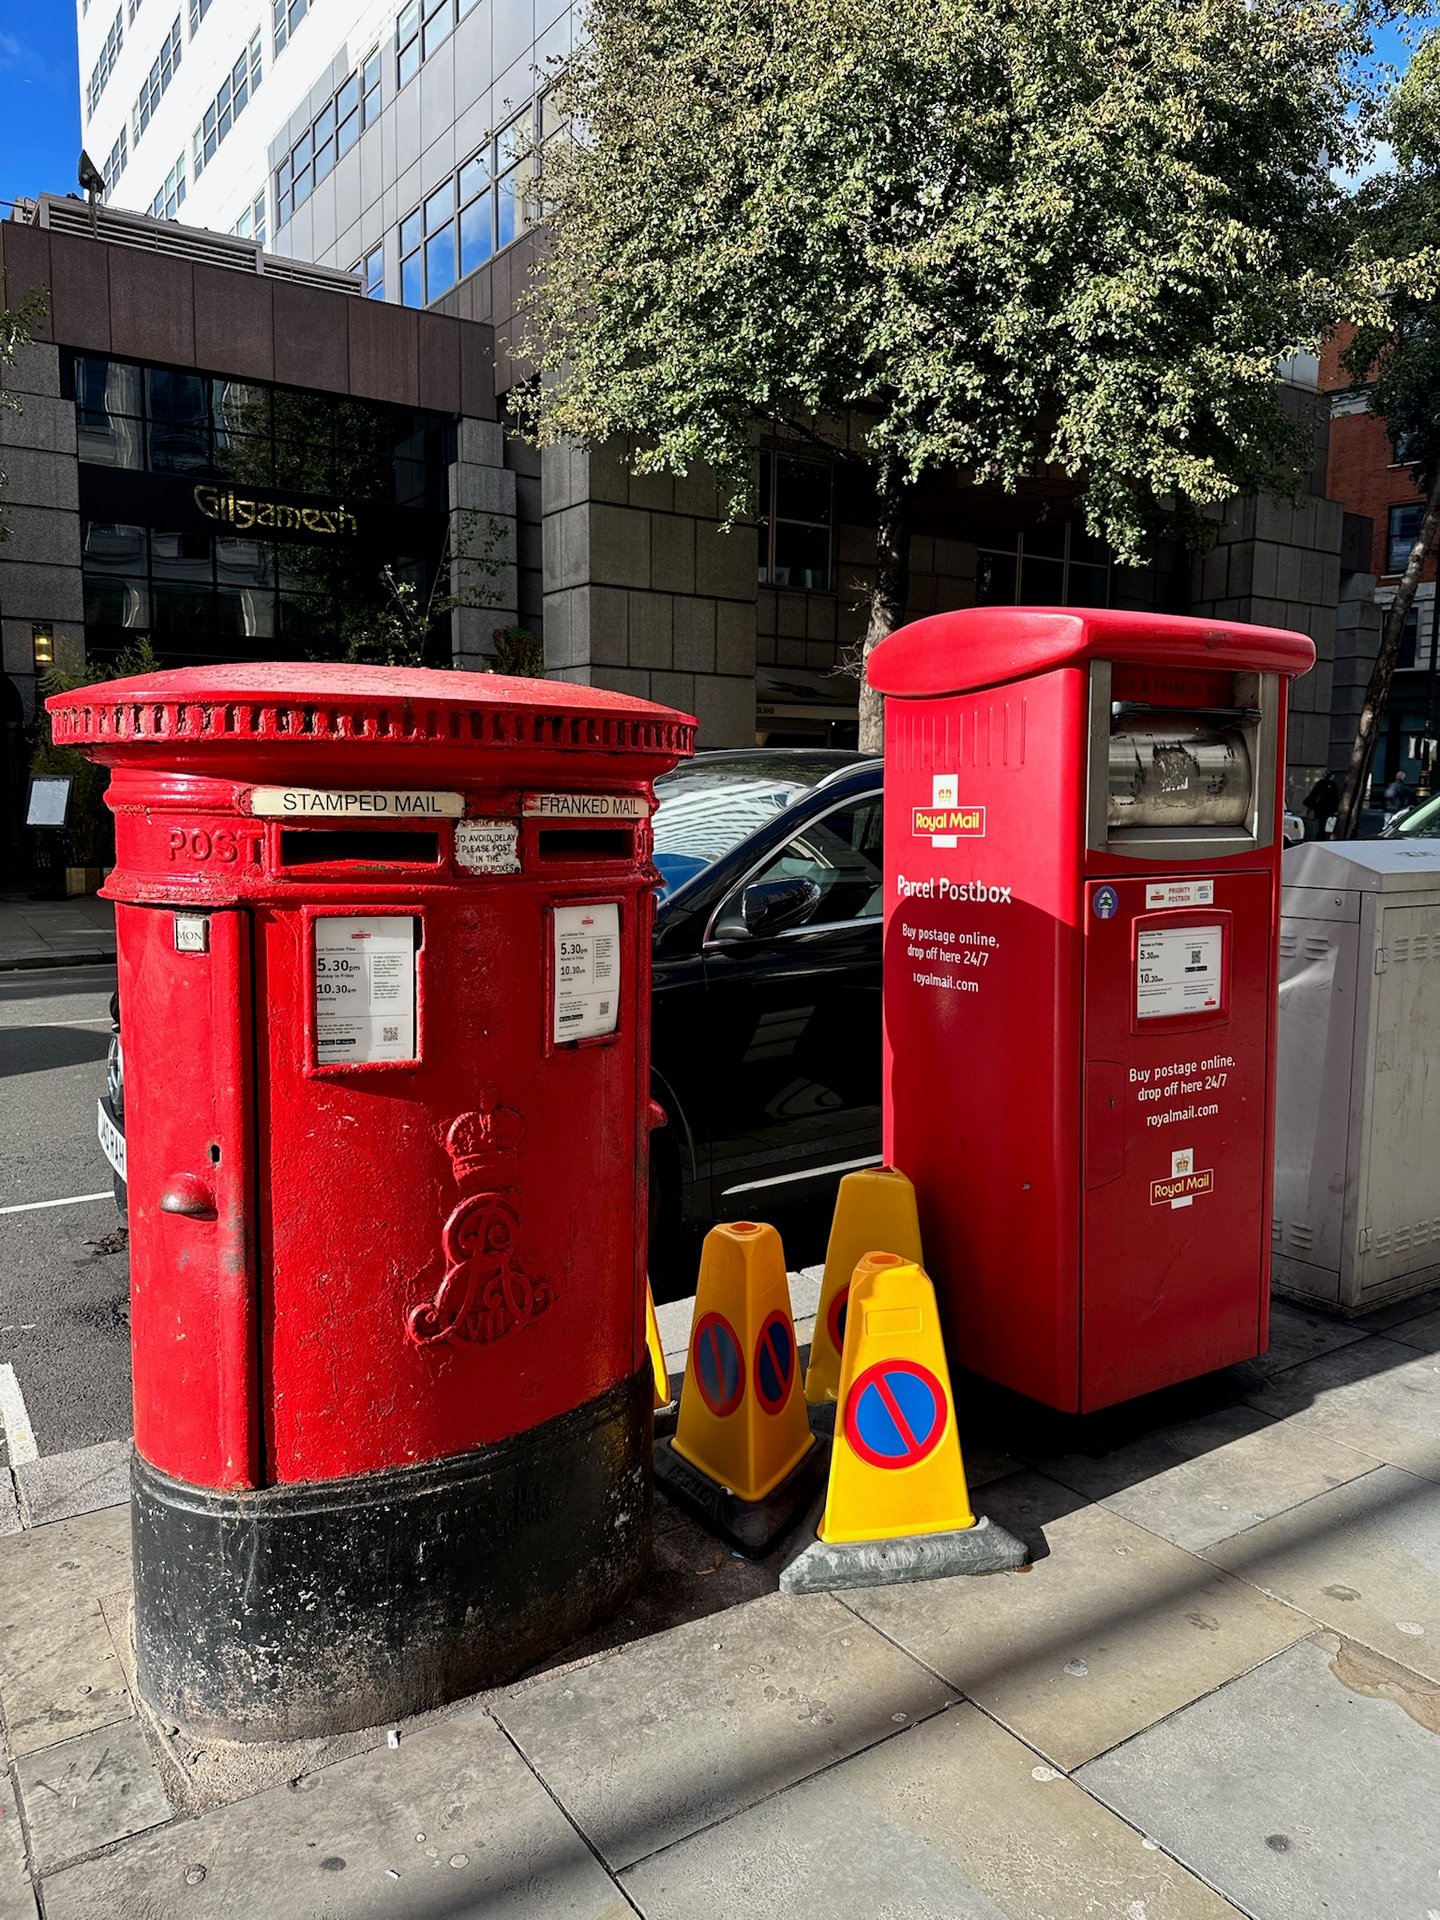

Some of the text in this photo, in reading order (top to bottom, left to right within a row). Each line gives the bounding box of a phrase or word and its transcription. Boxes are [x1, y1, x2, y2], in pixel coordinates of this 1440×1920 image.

[193, 485, 357, 536] Gilgamesh
[283, 793, 442, 812] STAMPED MAIL
[540, 796, 639, 815] FRANKED MAIL
[915, 811, 980, 832] Royal Mail
[169, 827, 264, 864] POST
[456, 834, 467, 843] TO
[494, 834, 516, 842] DELAY
[461, 843, 512, 853] PLEASE POST
[475, 854, 500, 863] IN THE
[490, 863, 514, 873] BOXES
[897, 874, 1012, 904] Parcel Postbox
[1168, 886, 1191, 894] PRIORITY
[1168, 895, 1190, 903] POSTBOX
[178, 931, 202, 940] MON
[902, 923, 1000, 949] Buy postage online,
[560, 942, 588, 955] 5.30pm
[907, 943, 989, 967] drop off here 24/7
[317, 957, 360, 973] 5.30pm
[316, 983, 357, 994] 10.30am
[1129, 1054, 1236, 1083] Buy postage online,
[1137, 1073, 1228, 1102] drop off here 24/7
[1146, 1103, 1219, 1128] royalmail.com
[1154, 1173, 1210, 1199] Royal Mail
